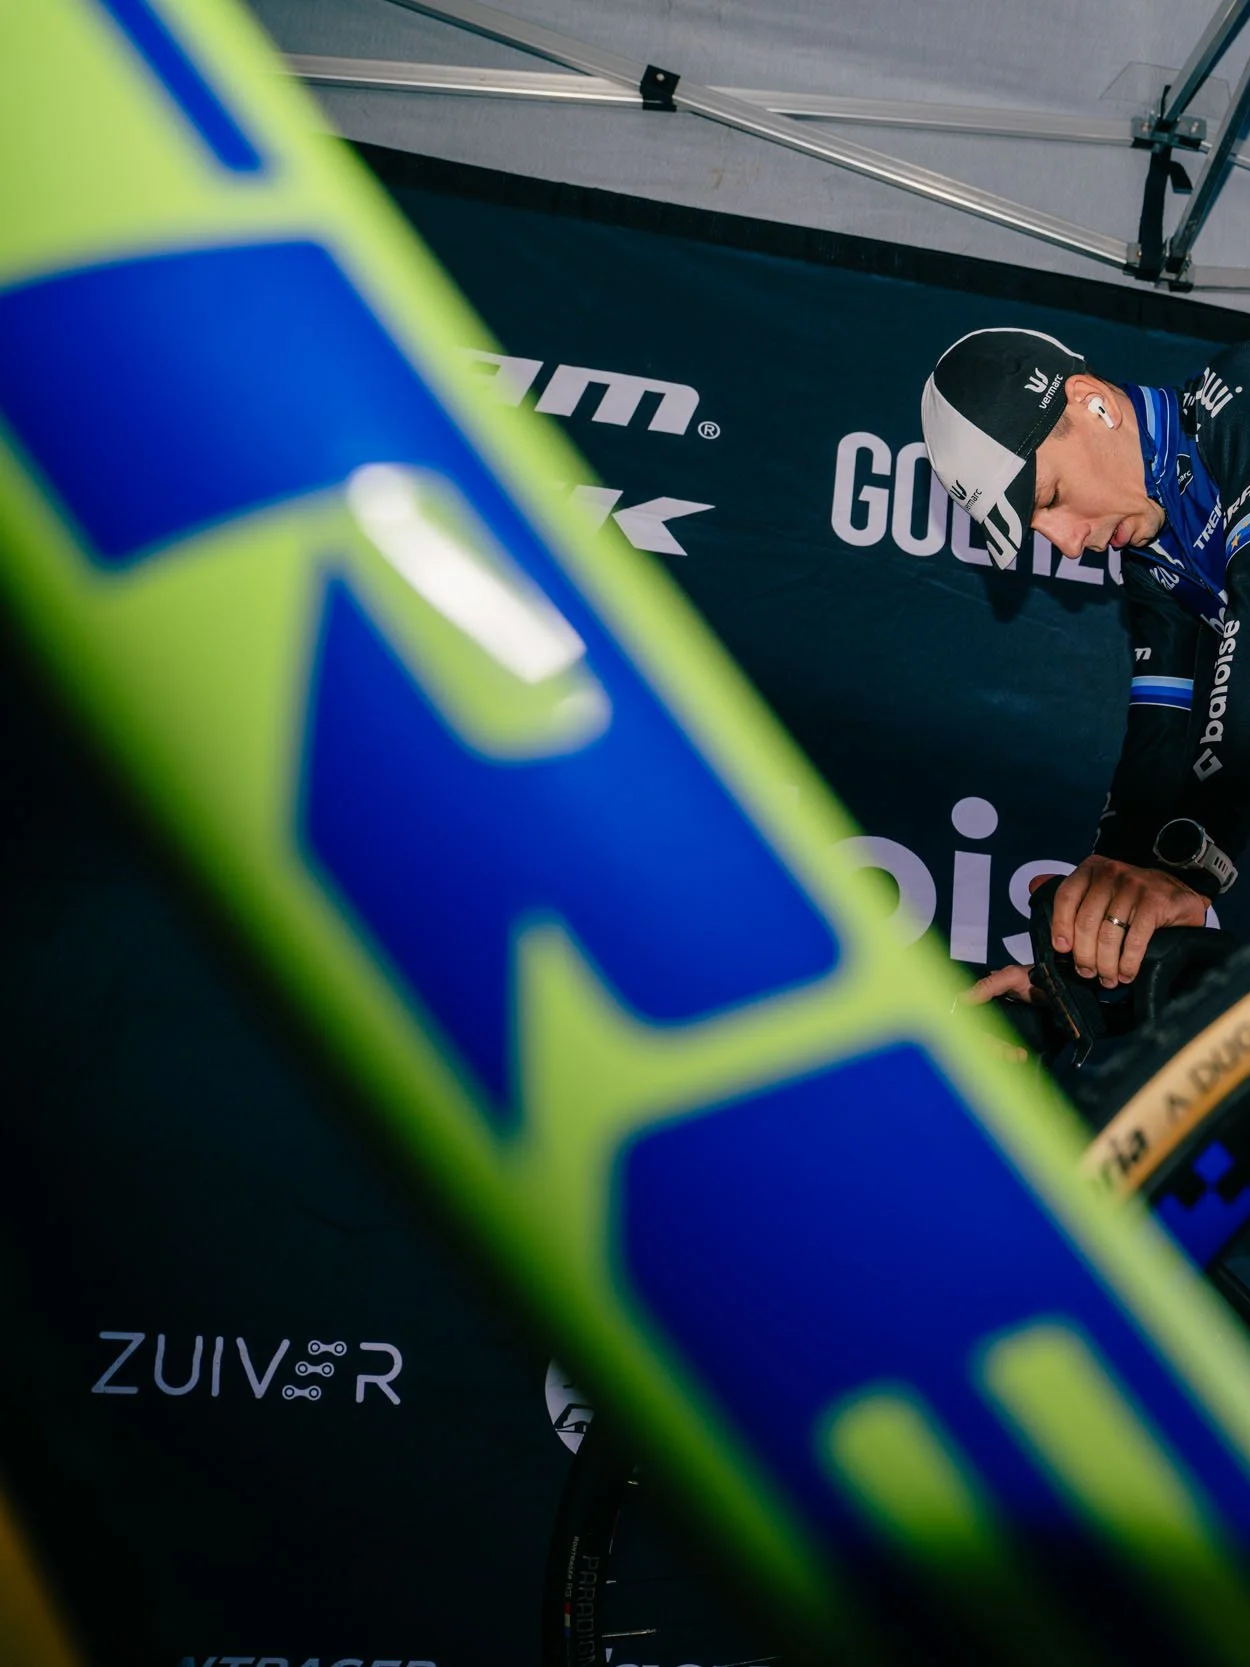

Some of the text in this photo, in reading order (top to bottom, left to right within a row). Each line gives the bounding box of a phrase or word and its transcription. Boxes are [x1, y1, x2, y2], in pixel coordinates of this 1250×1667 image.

[1039, 373, 1064, 410] vermarc
[1199, 619, 1240, 744] baloise
[92, 1331, 402, 1405] ZUIVER
